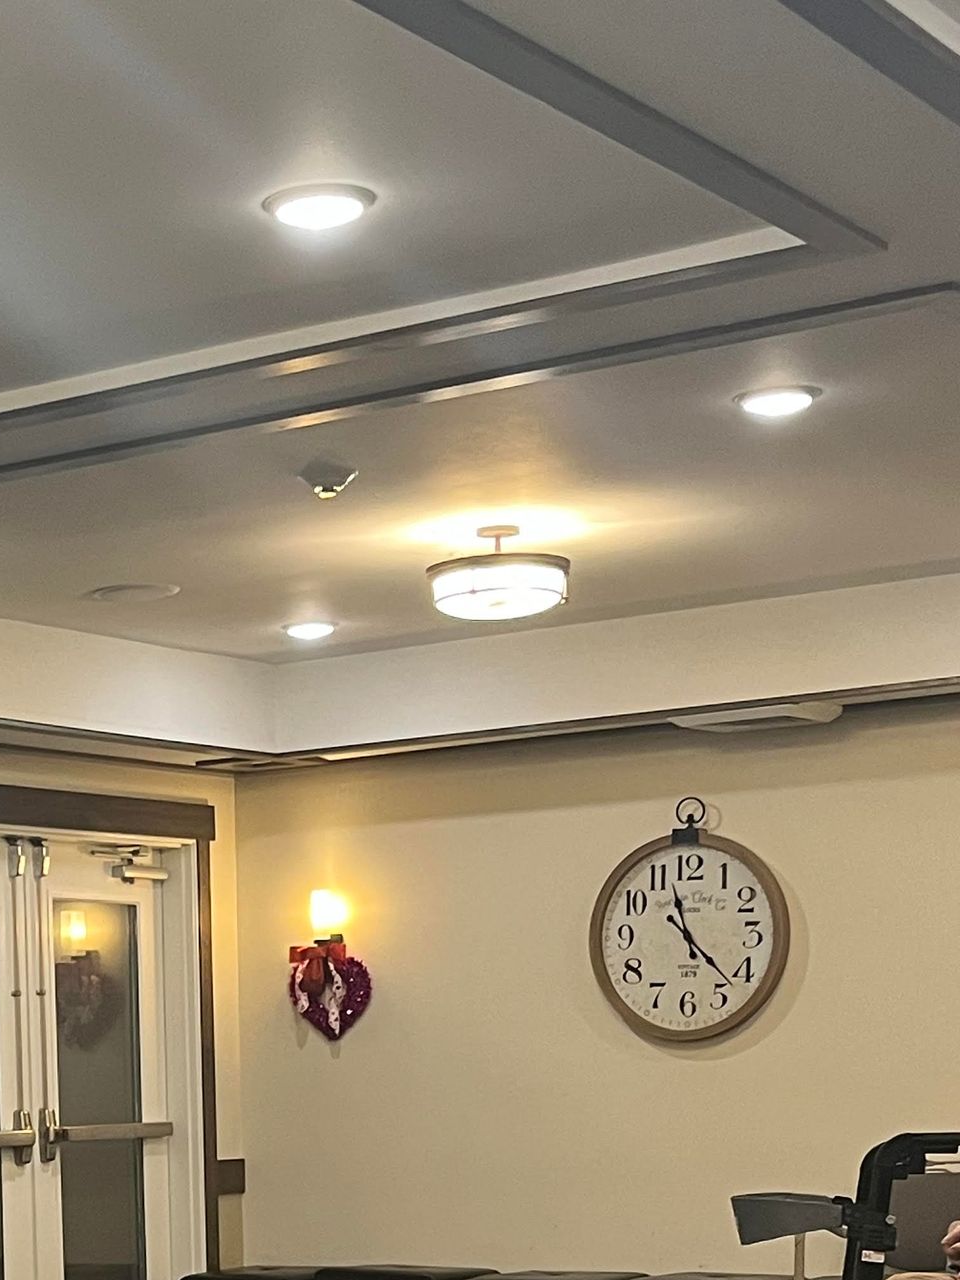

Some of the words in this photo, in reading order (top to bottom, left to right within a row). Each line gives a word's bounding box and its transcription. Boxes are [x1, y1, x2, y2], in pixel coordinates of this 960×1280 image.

[650, 864, 667, 891] 11
[677, 853, 704, 881] 12
[719, 862, 728, 890] 1
[626, 889, 648, 916] 10
[737, 886, 756, 913] 2
[617, 924, 635, 951] 9
[742, 920, 763, 949] 3
[622, 958, 642, 985] 8
[732, 956, 755, 983] 4
[649, 982, 666, 1009] 7
[679, 991, 697, 1018] 6
[710, 983, 728, 1010] 5
